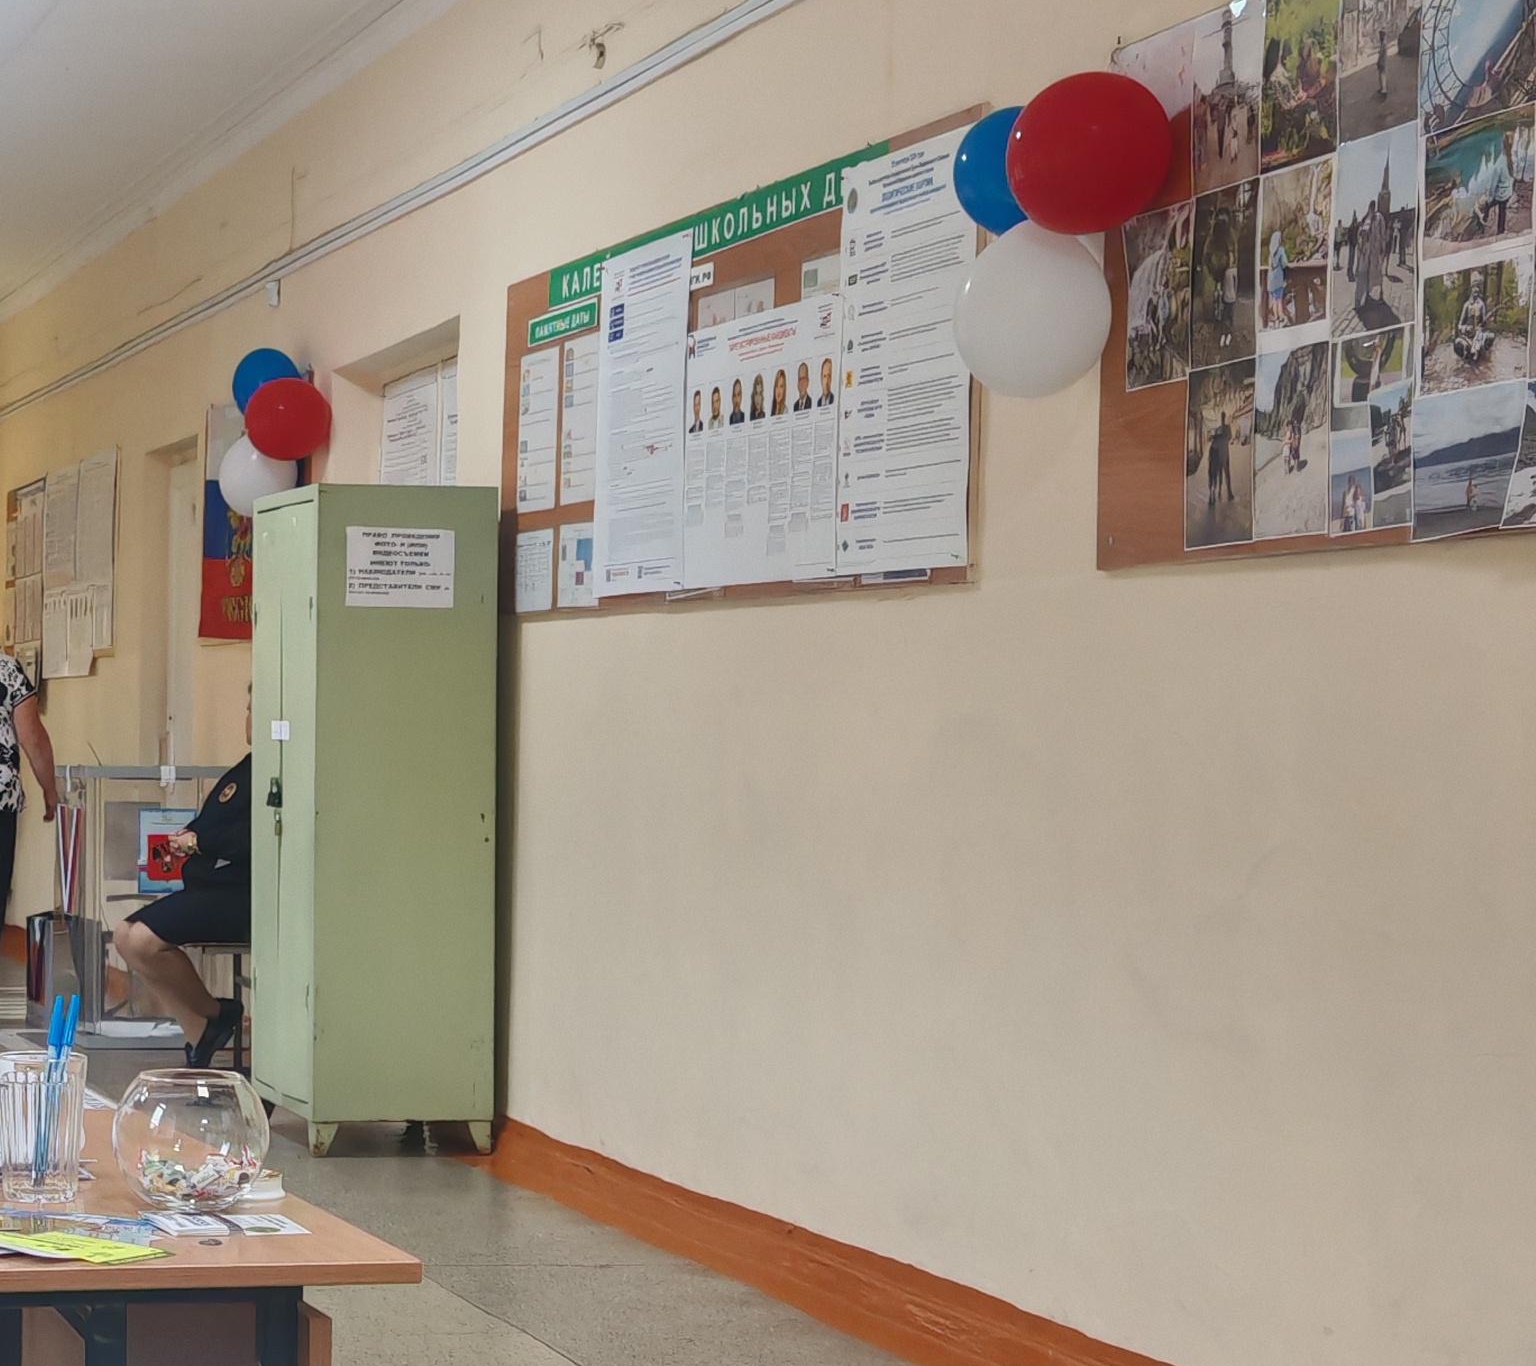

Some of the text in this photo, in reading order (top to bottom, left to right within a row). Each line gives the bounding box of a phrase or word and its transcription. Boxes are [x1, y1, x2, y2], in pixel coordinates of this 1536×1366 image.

[562, 255, 610, 298] КАЛЕ
[695, 181, 811, 251] ШКОЛЬНЫХ
[571, 310, 590, 329] ДАТЫ
